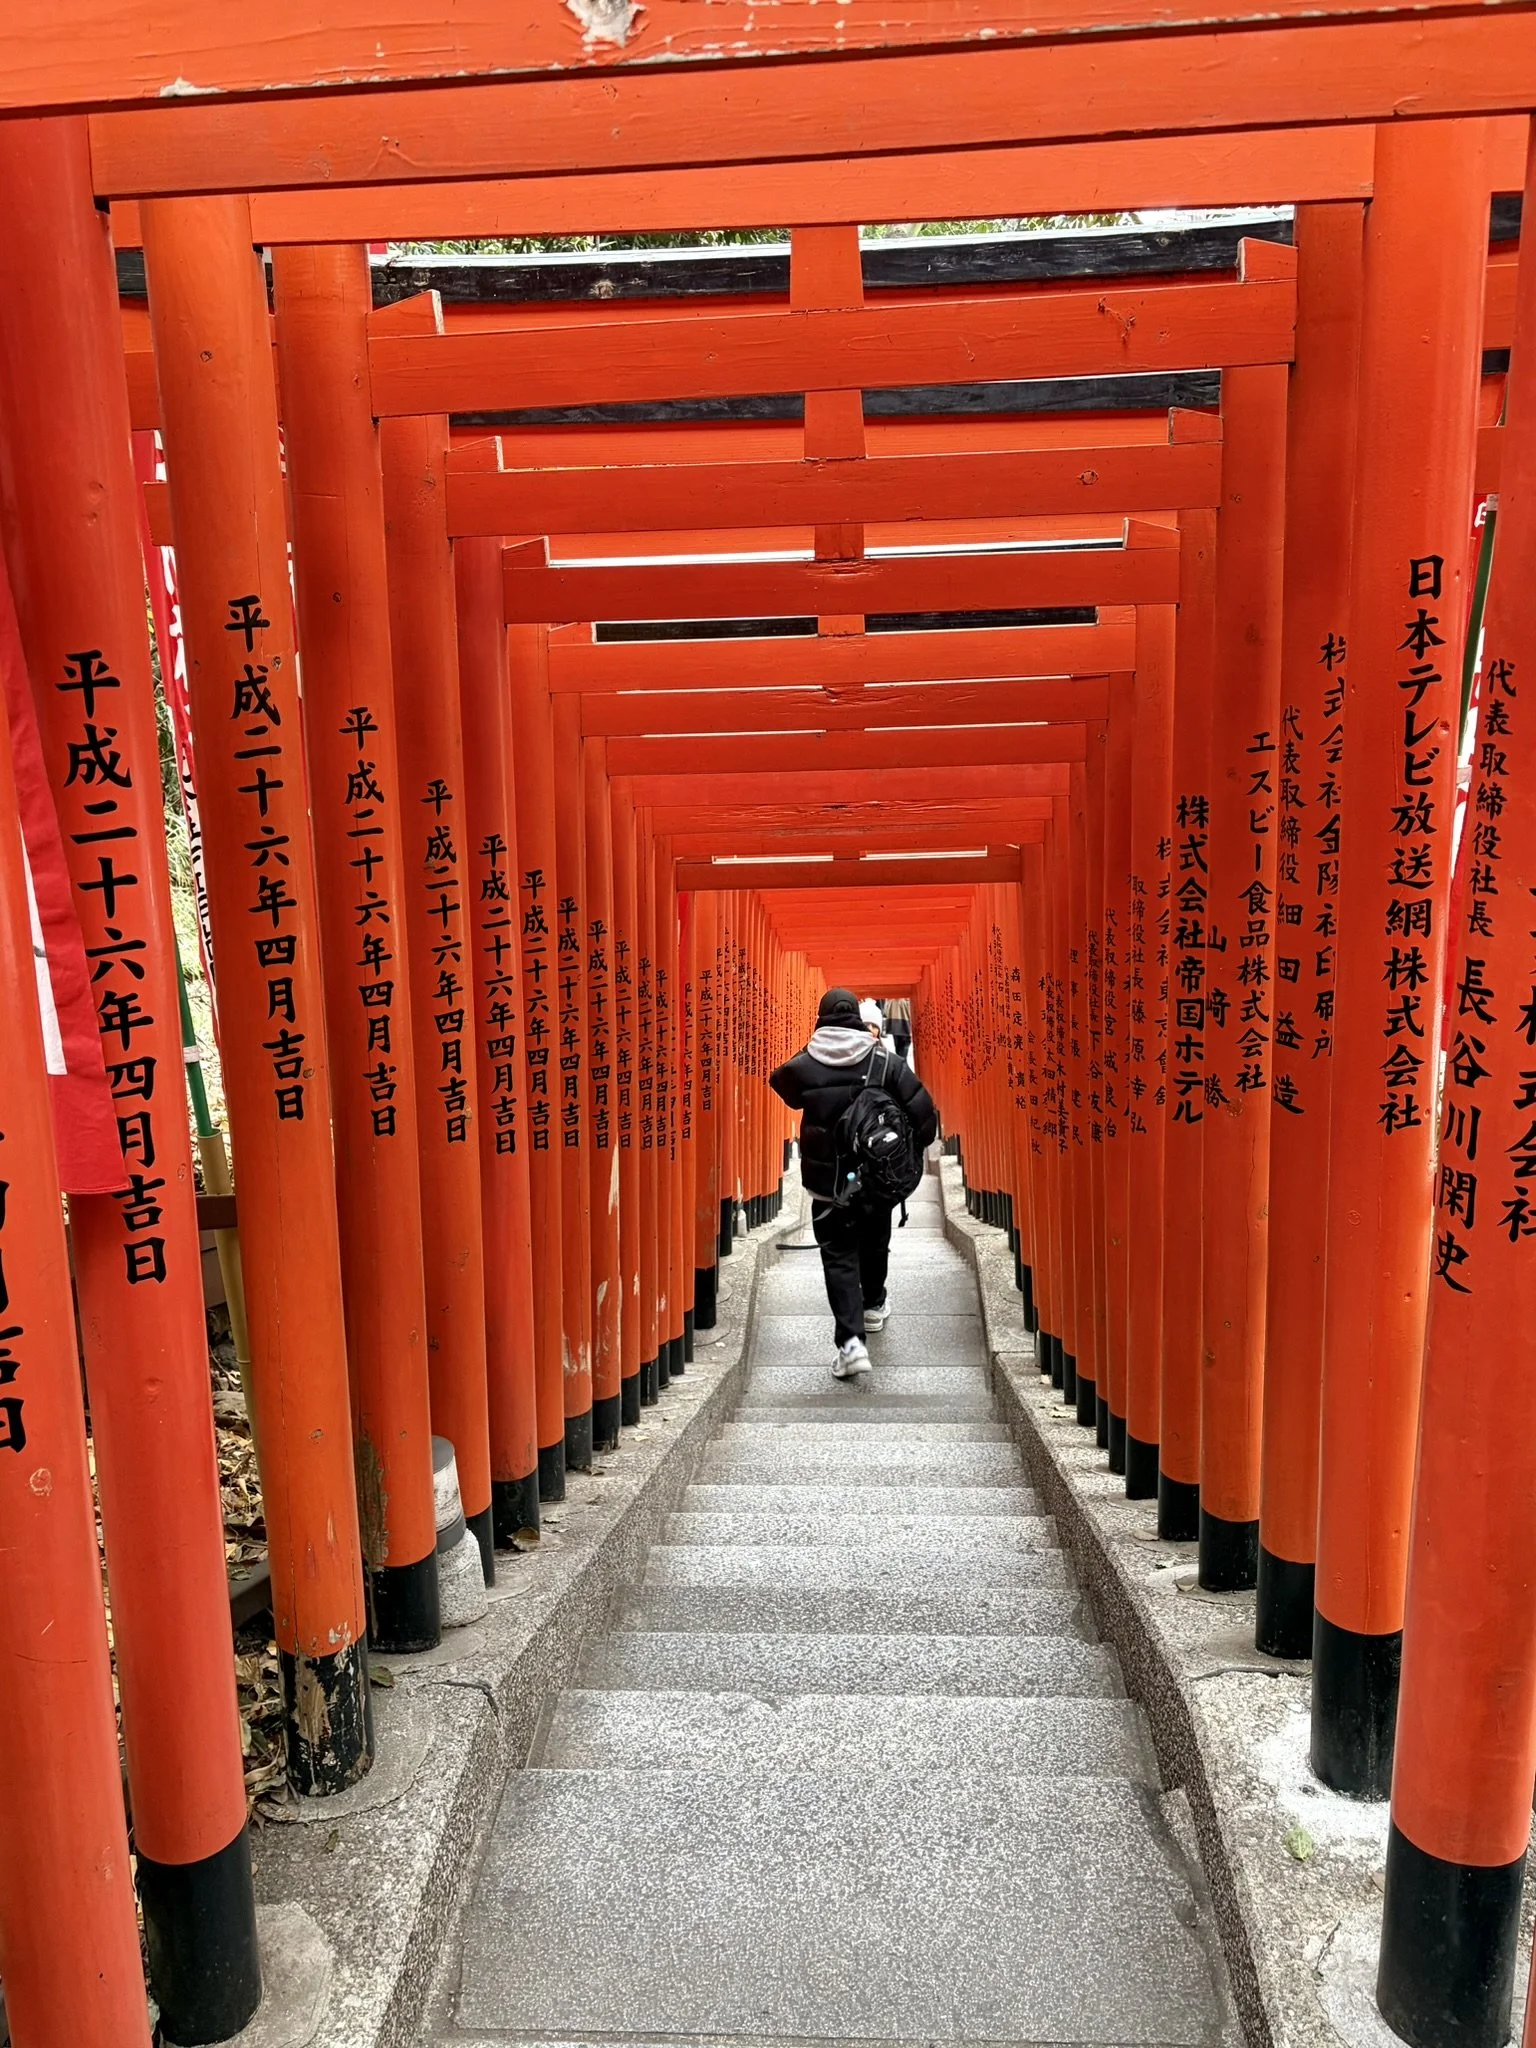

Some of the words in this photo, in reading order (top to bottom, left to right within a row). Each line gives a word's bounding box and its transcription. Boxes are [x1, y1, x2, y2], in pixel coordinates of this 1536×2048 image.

[55, 651, 167, 1285] 平成二十六年四月吉日
[224, 595, 306, 1120] 平成二十六年四月吉日
[338, 706, 398, 1138] 平成二十六年四月吉日
[420, 778, 468, 1143] 平成二十六年四月吉日
[478, 833, 516, 1154] 平成二十六年四月吉日
[1172, 795, 1209, 1124] 株式会社帝国ホテル
[1234, 731, 1277, 1094] エスビー食品株式会社
[1377, 554, 1446, 1136] 日本テレビ放送網株式会社
[521, 869, 551, 1151] 平成二十六年四月吉日
[557, 896, 580, 1148] 平成二十六年四月吉日
[587, 919, 611, 1149] 平成二十六年四月吉日
[615, 940, 633, 1148] 平成二十六年四月吉日
[638, 957, 654, 1150] 平成二十六年四月吉日
[655, 968, 669, 1148] 平成二十六年四月吉日
[700, 970, 713, 1111] 平成二十六年四月吉日
